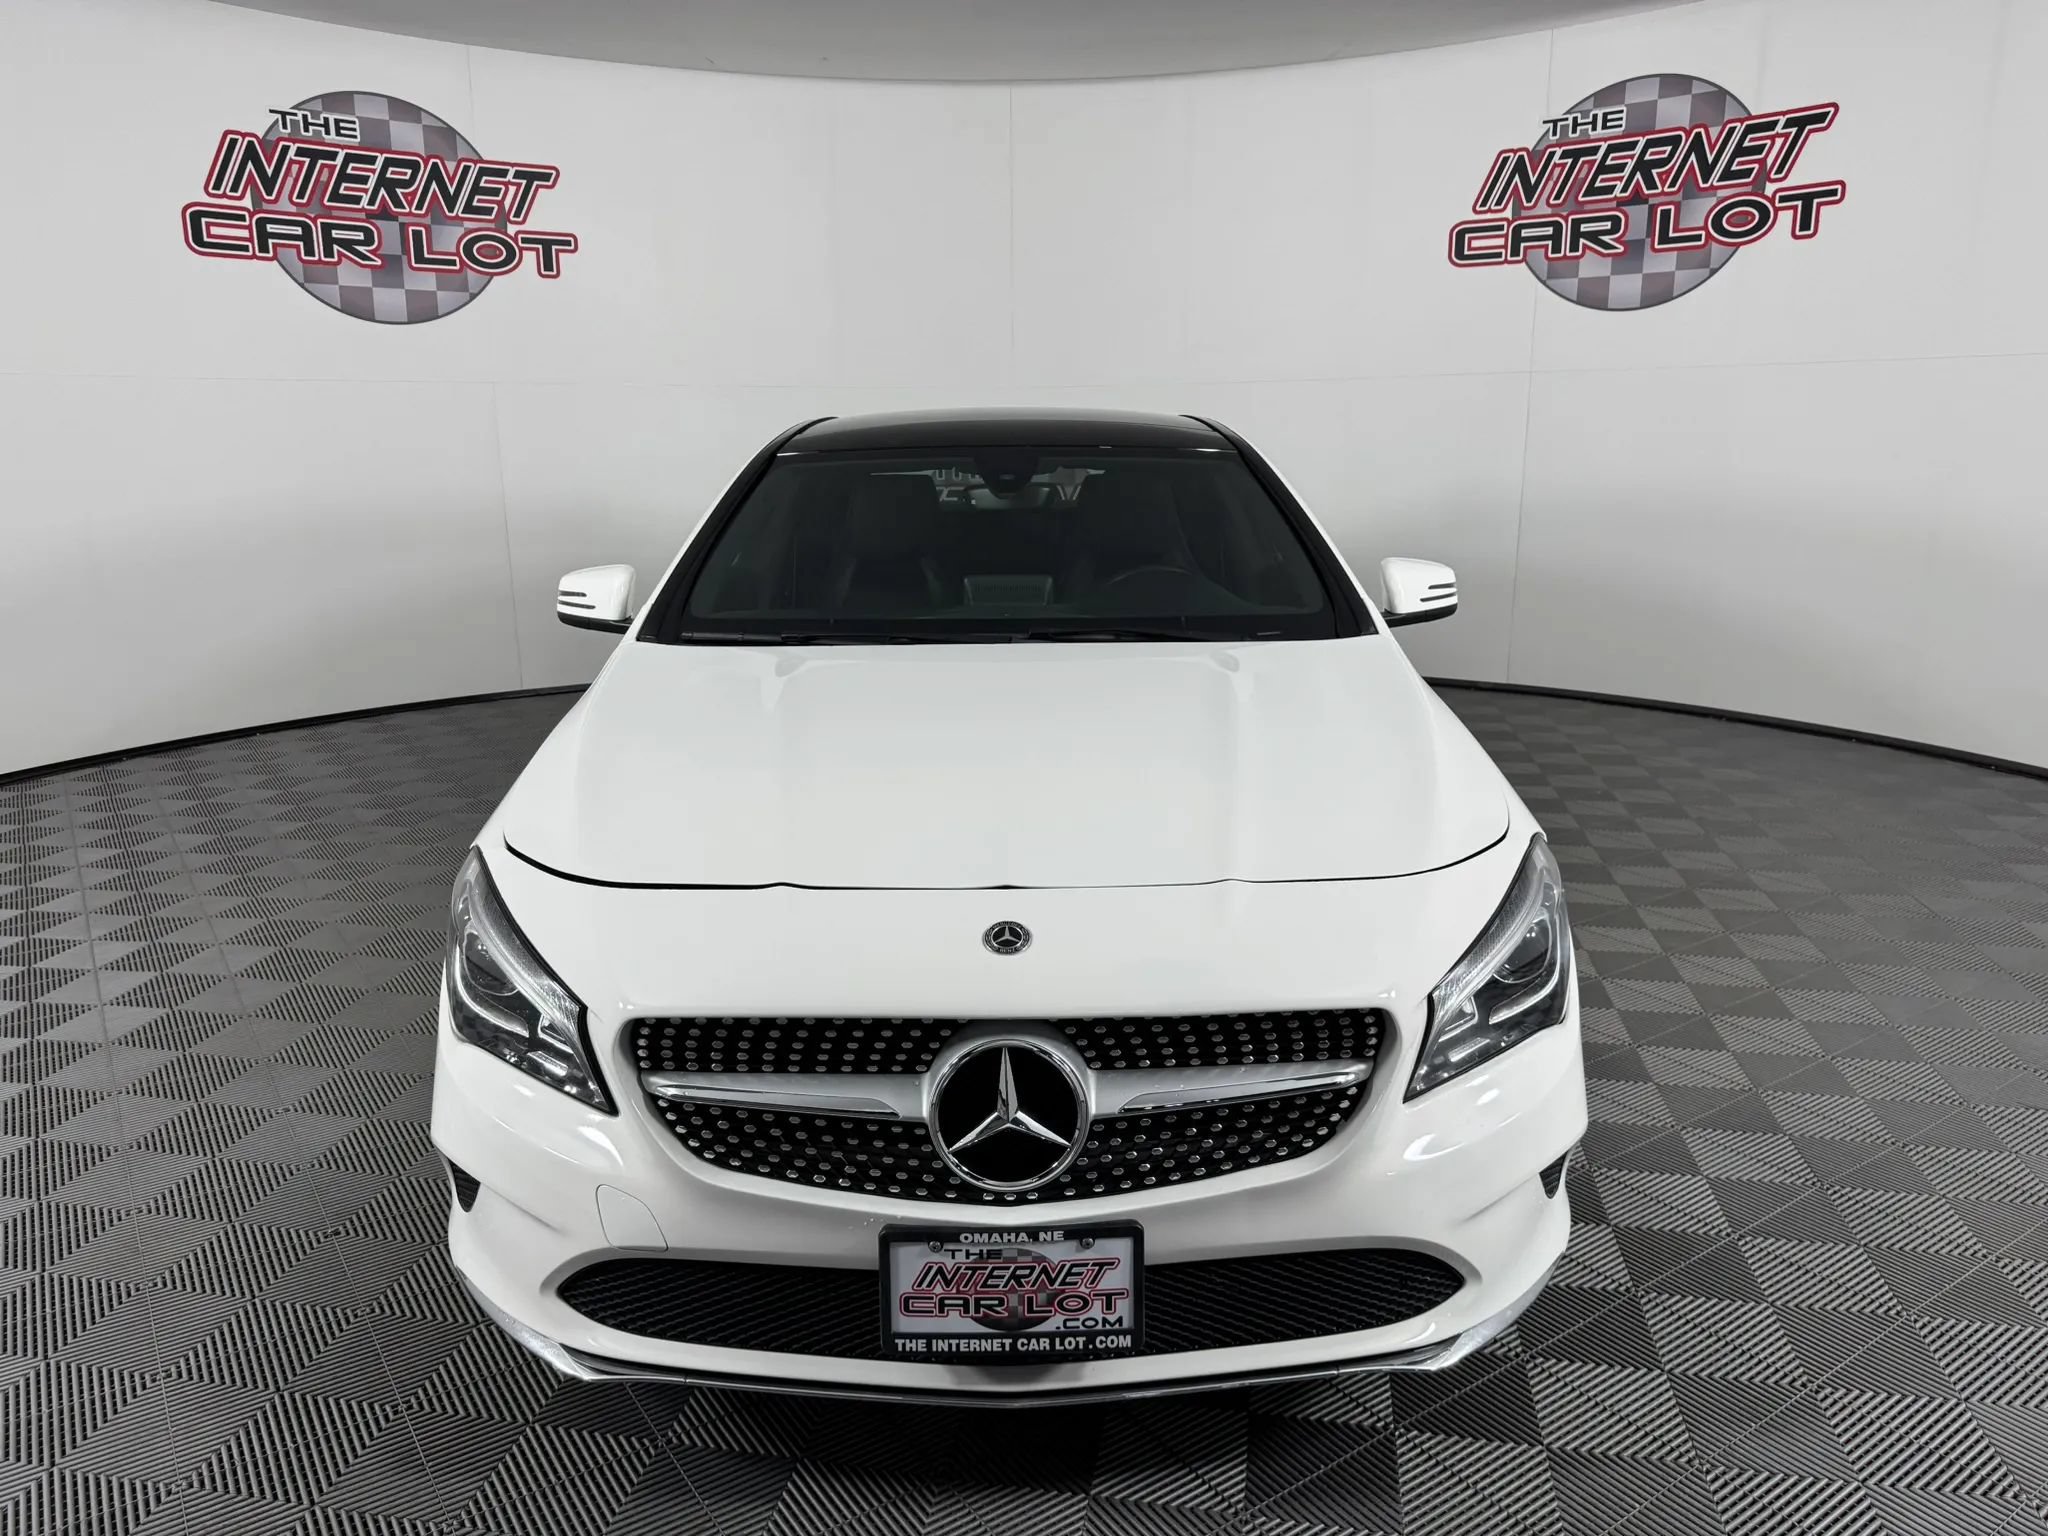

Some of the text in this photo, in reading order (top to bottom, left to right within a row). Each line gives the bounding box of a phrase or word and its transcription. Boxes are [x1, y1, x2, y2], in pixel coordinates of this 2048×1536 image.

[267, 107, 360, 141] THE
[1542, 107, 1627, 139] THE
[1474, 104, 1837, 213] INTERNET
[206, 132, 558, 222] INTERNET
[1450, 181, 1844, 264] CAR LOT
[184, 203, 576, 276] CAR LOT
[1039, 1231, 1065, 1242] NE
[943, 1248, 1003, 1260] THE
[913, 1259, 1119, 1291] INTERNET
[901, 1289, 1128, 1317] CAR LOT
[1056, 1316, 1123, 1330] .COM
[894, 1339, 927, 1352] THE
[932, 1339, 1012, 1352] INTERNET
[1017, 1338, 1050, 1351] CAR
